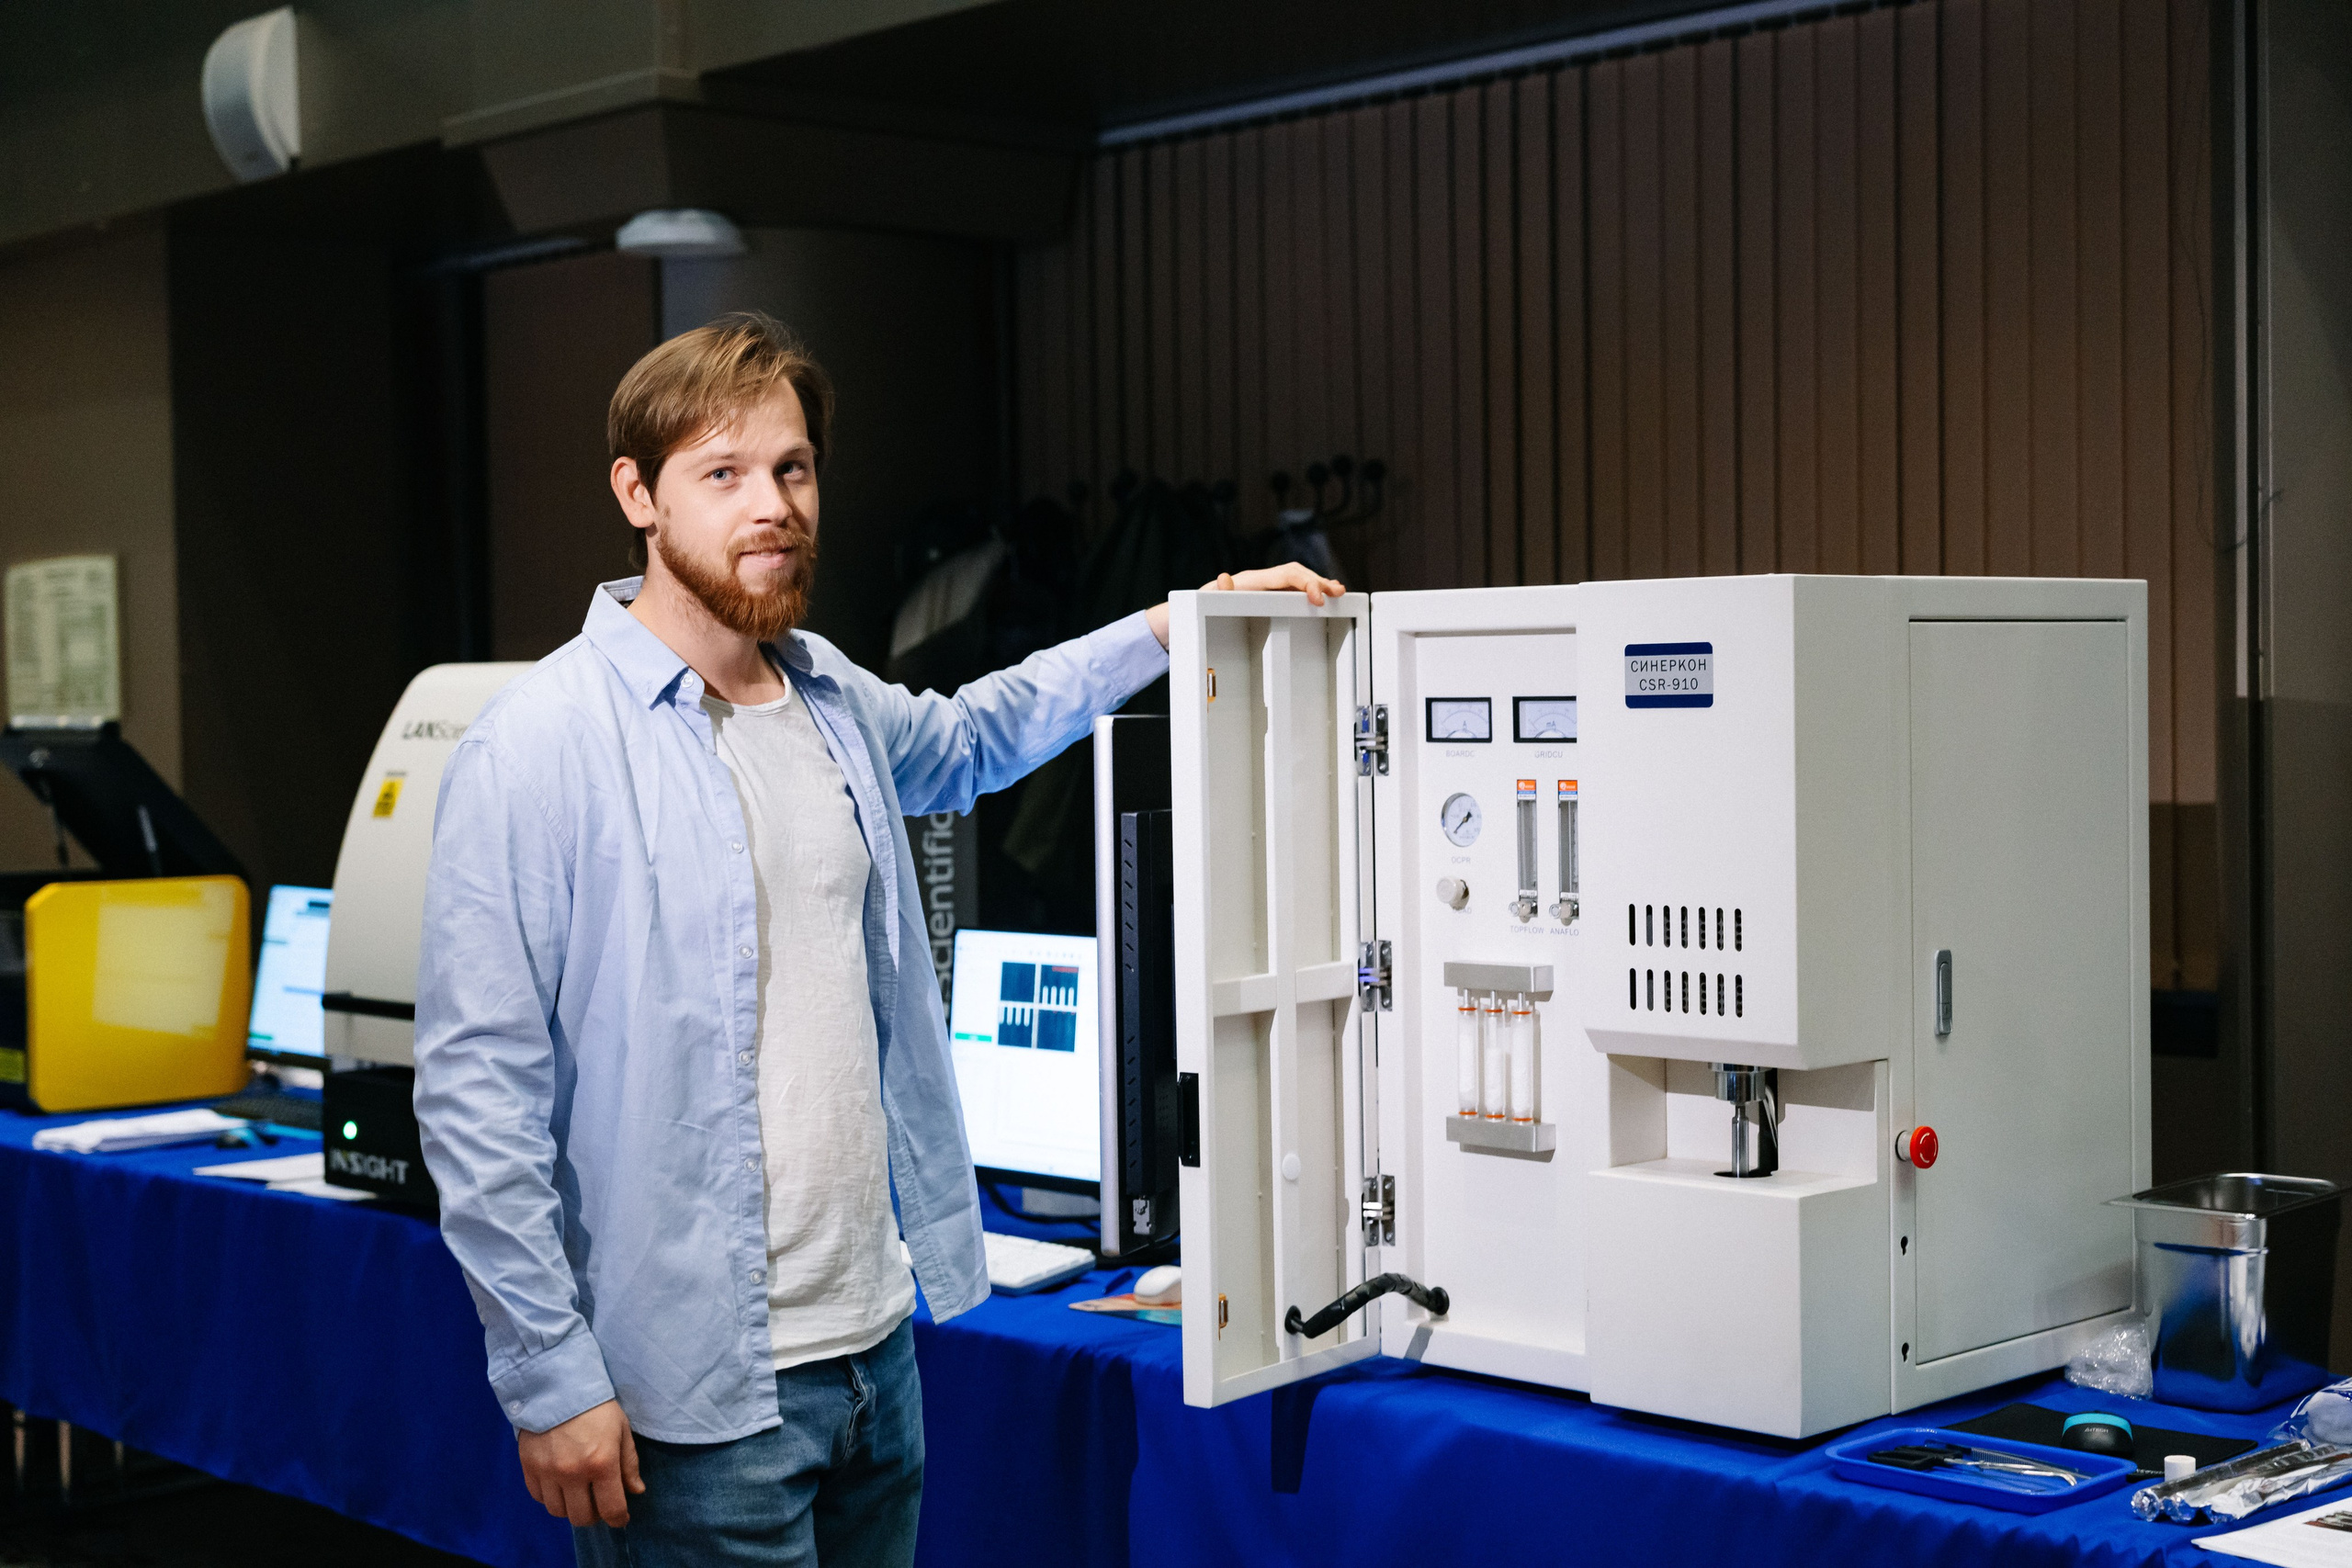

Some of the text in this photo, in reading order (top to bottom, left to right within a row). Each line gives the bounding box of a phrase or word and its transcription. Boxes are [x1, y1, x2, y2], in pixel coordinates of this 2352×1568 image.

[1630, 659, 1706, 672] СИНЕРКОН
[1639, 677, 1699, 691] CSR-910
[1510, 925, 1544, 934] TOPFLOW
[1550, 927, 1579, 937] ANAFLO
